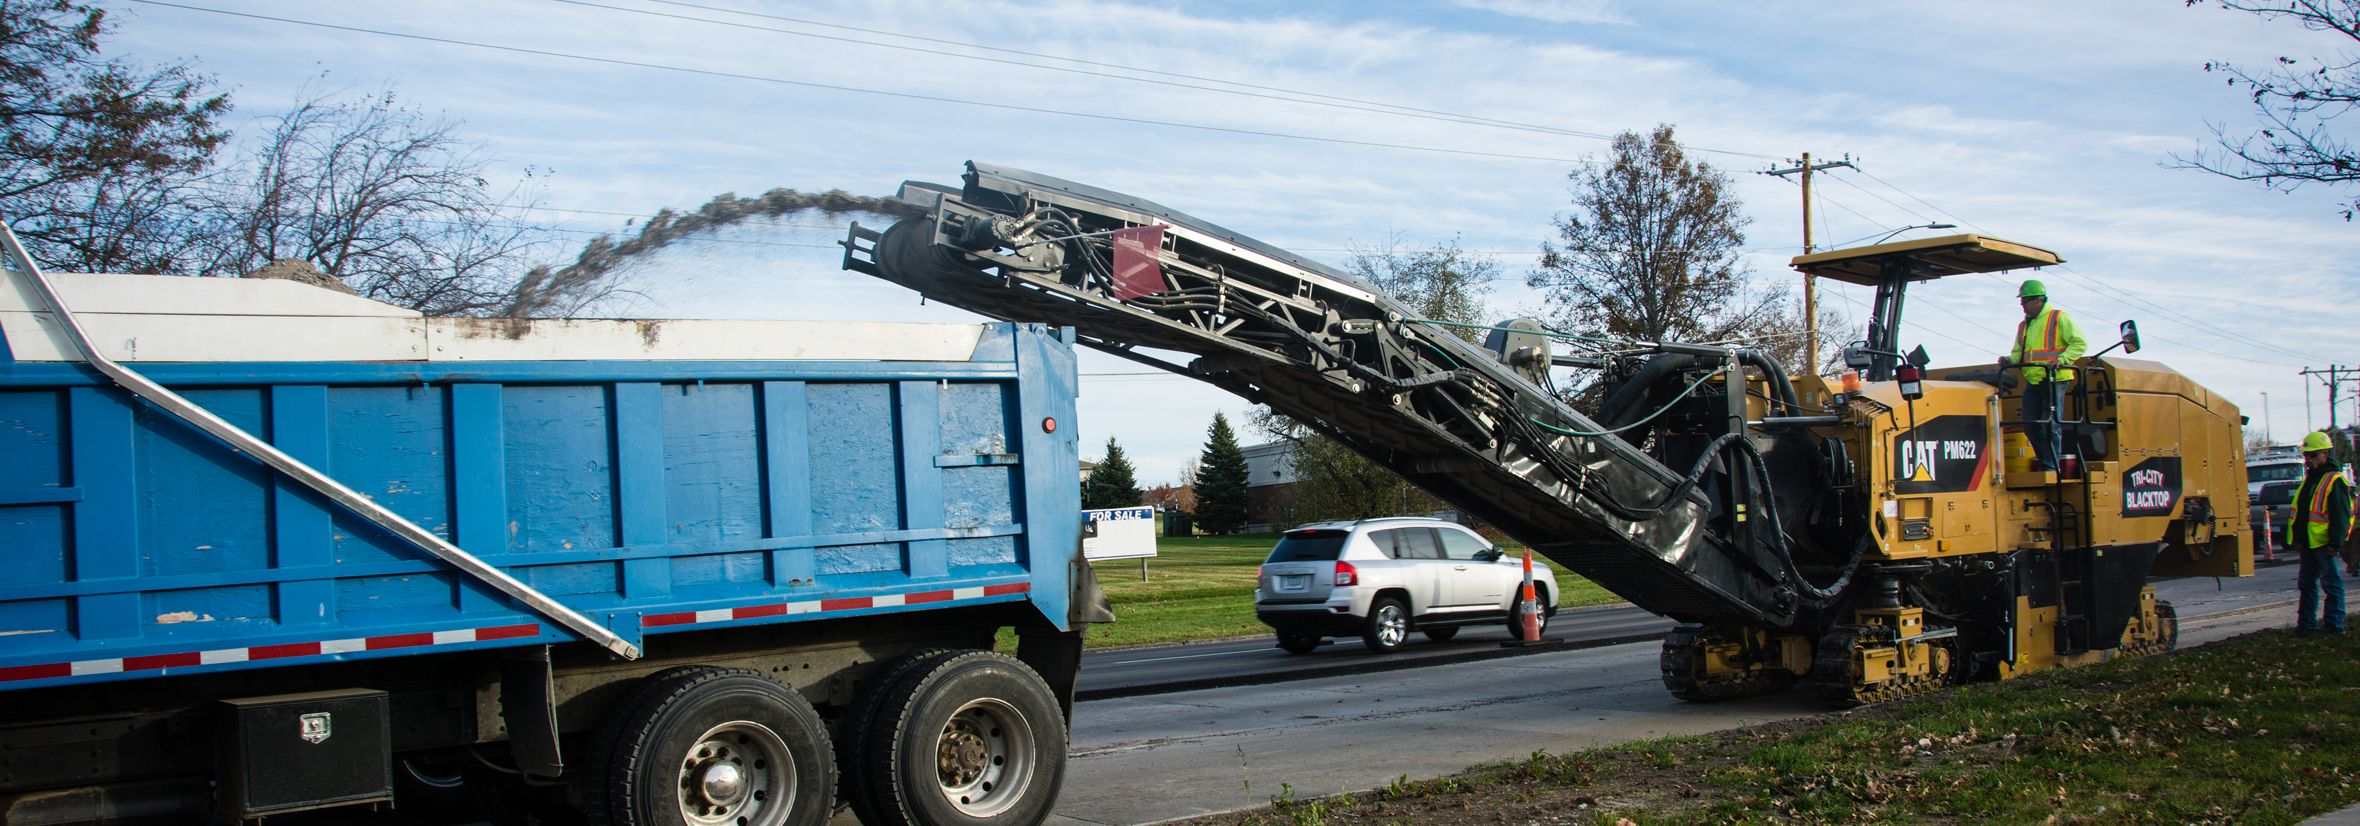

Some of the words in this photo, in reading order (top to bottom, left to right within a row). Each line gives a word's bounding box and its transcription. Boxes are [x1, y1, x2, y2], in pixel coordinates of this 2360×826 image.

[1902, 440, 1937, 481] CAT
[1944, 440, 1976, 460] PM622
[2130, 469, 2164, 487] TRI-CITY
[2126, 491, 2170, 508] BLACKTOP
[1090, 511, 1112, 521] FOR
[1114, 510, 1142, 520] SALE
